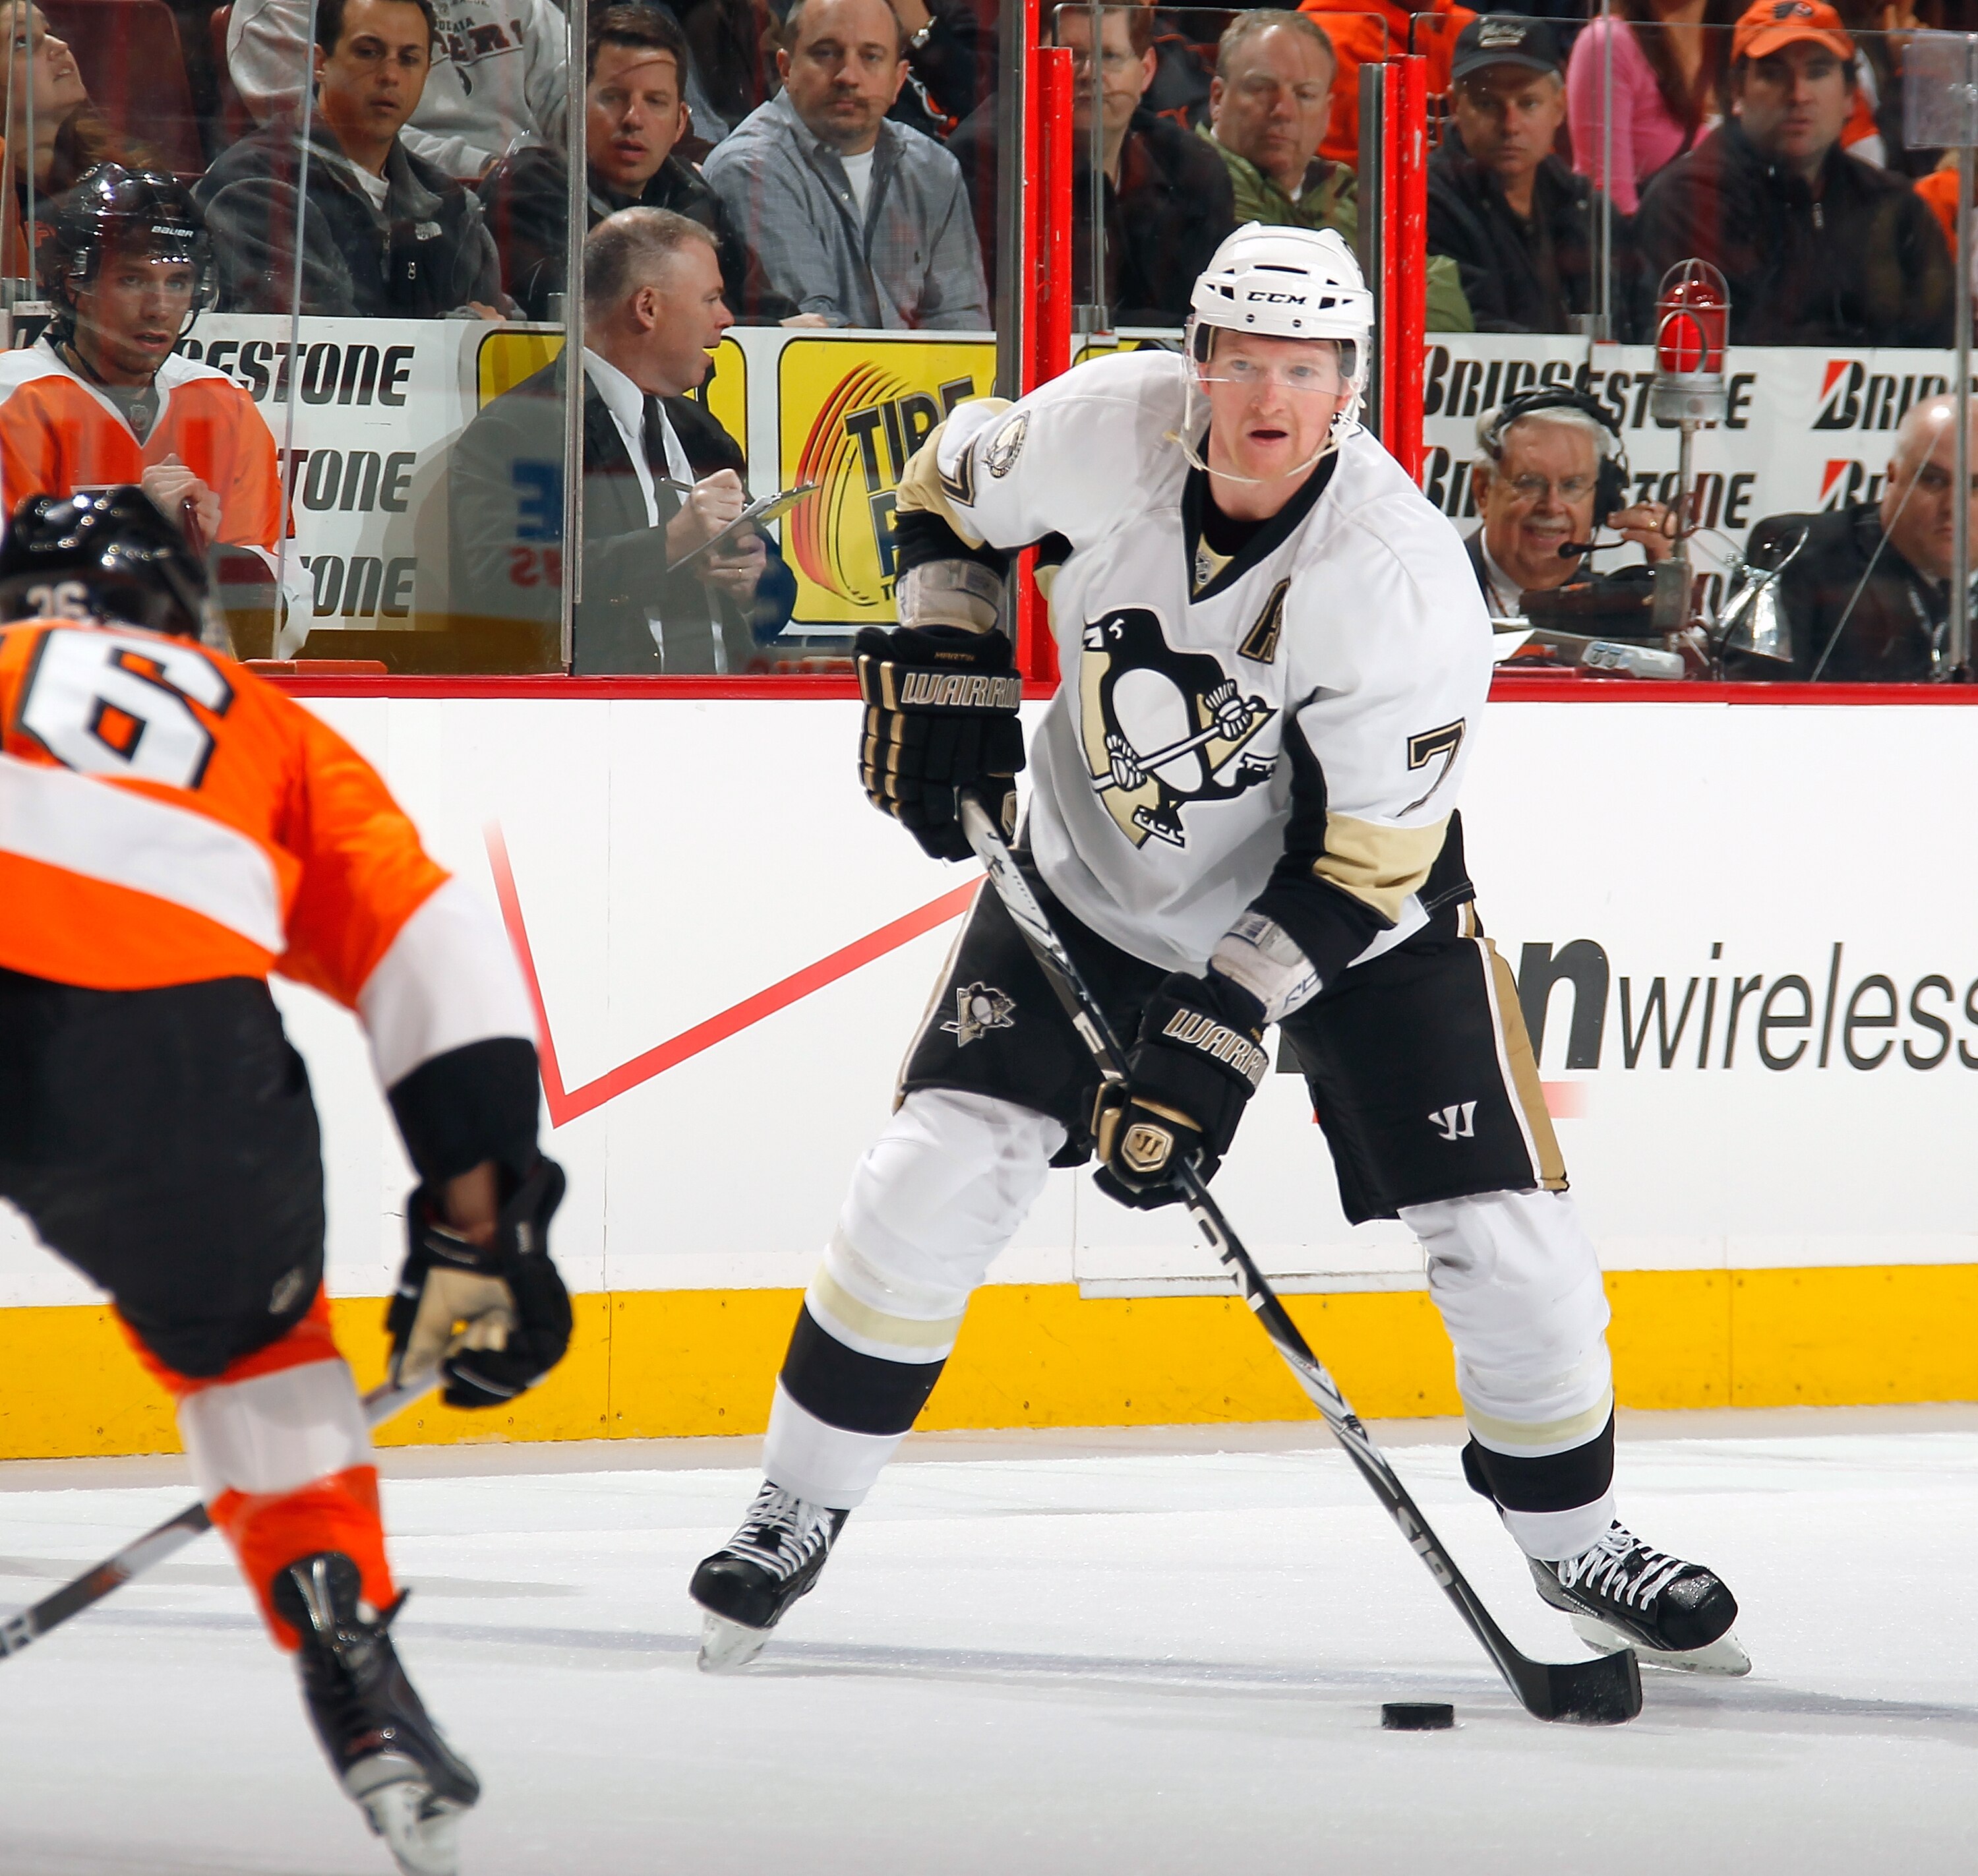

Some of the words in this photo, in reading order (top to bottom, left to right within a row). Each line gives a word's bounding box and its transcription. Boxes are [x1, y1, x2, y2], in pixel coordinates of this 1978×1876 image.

[151, 225, 195, 238] BAUER
[1246, 291, 1307, 305] CCM
[1237, 575, 1291, 665] A
[1396, 717, 1466, 818] 7
